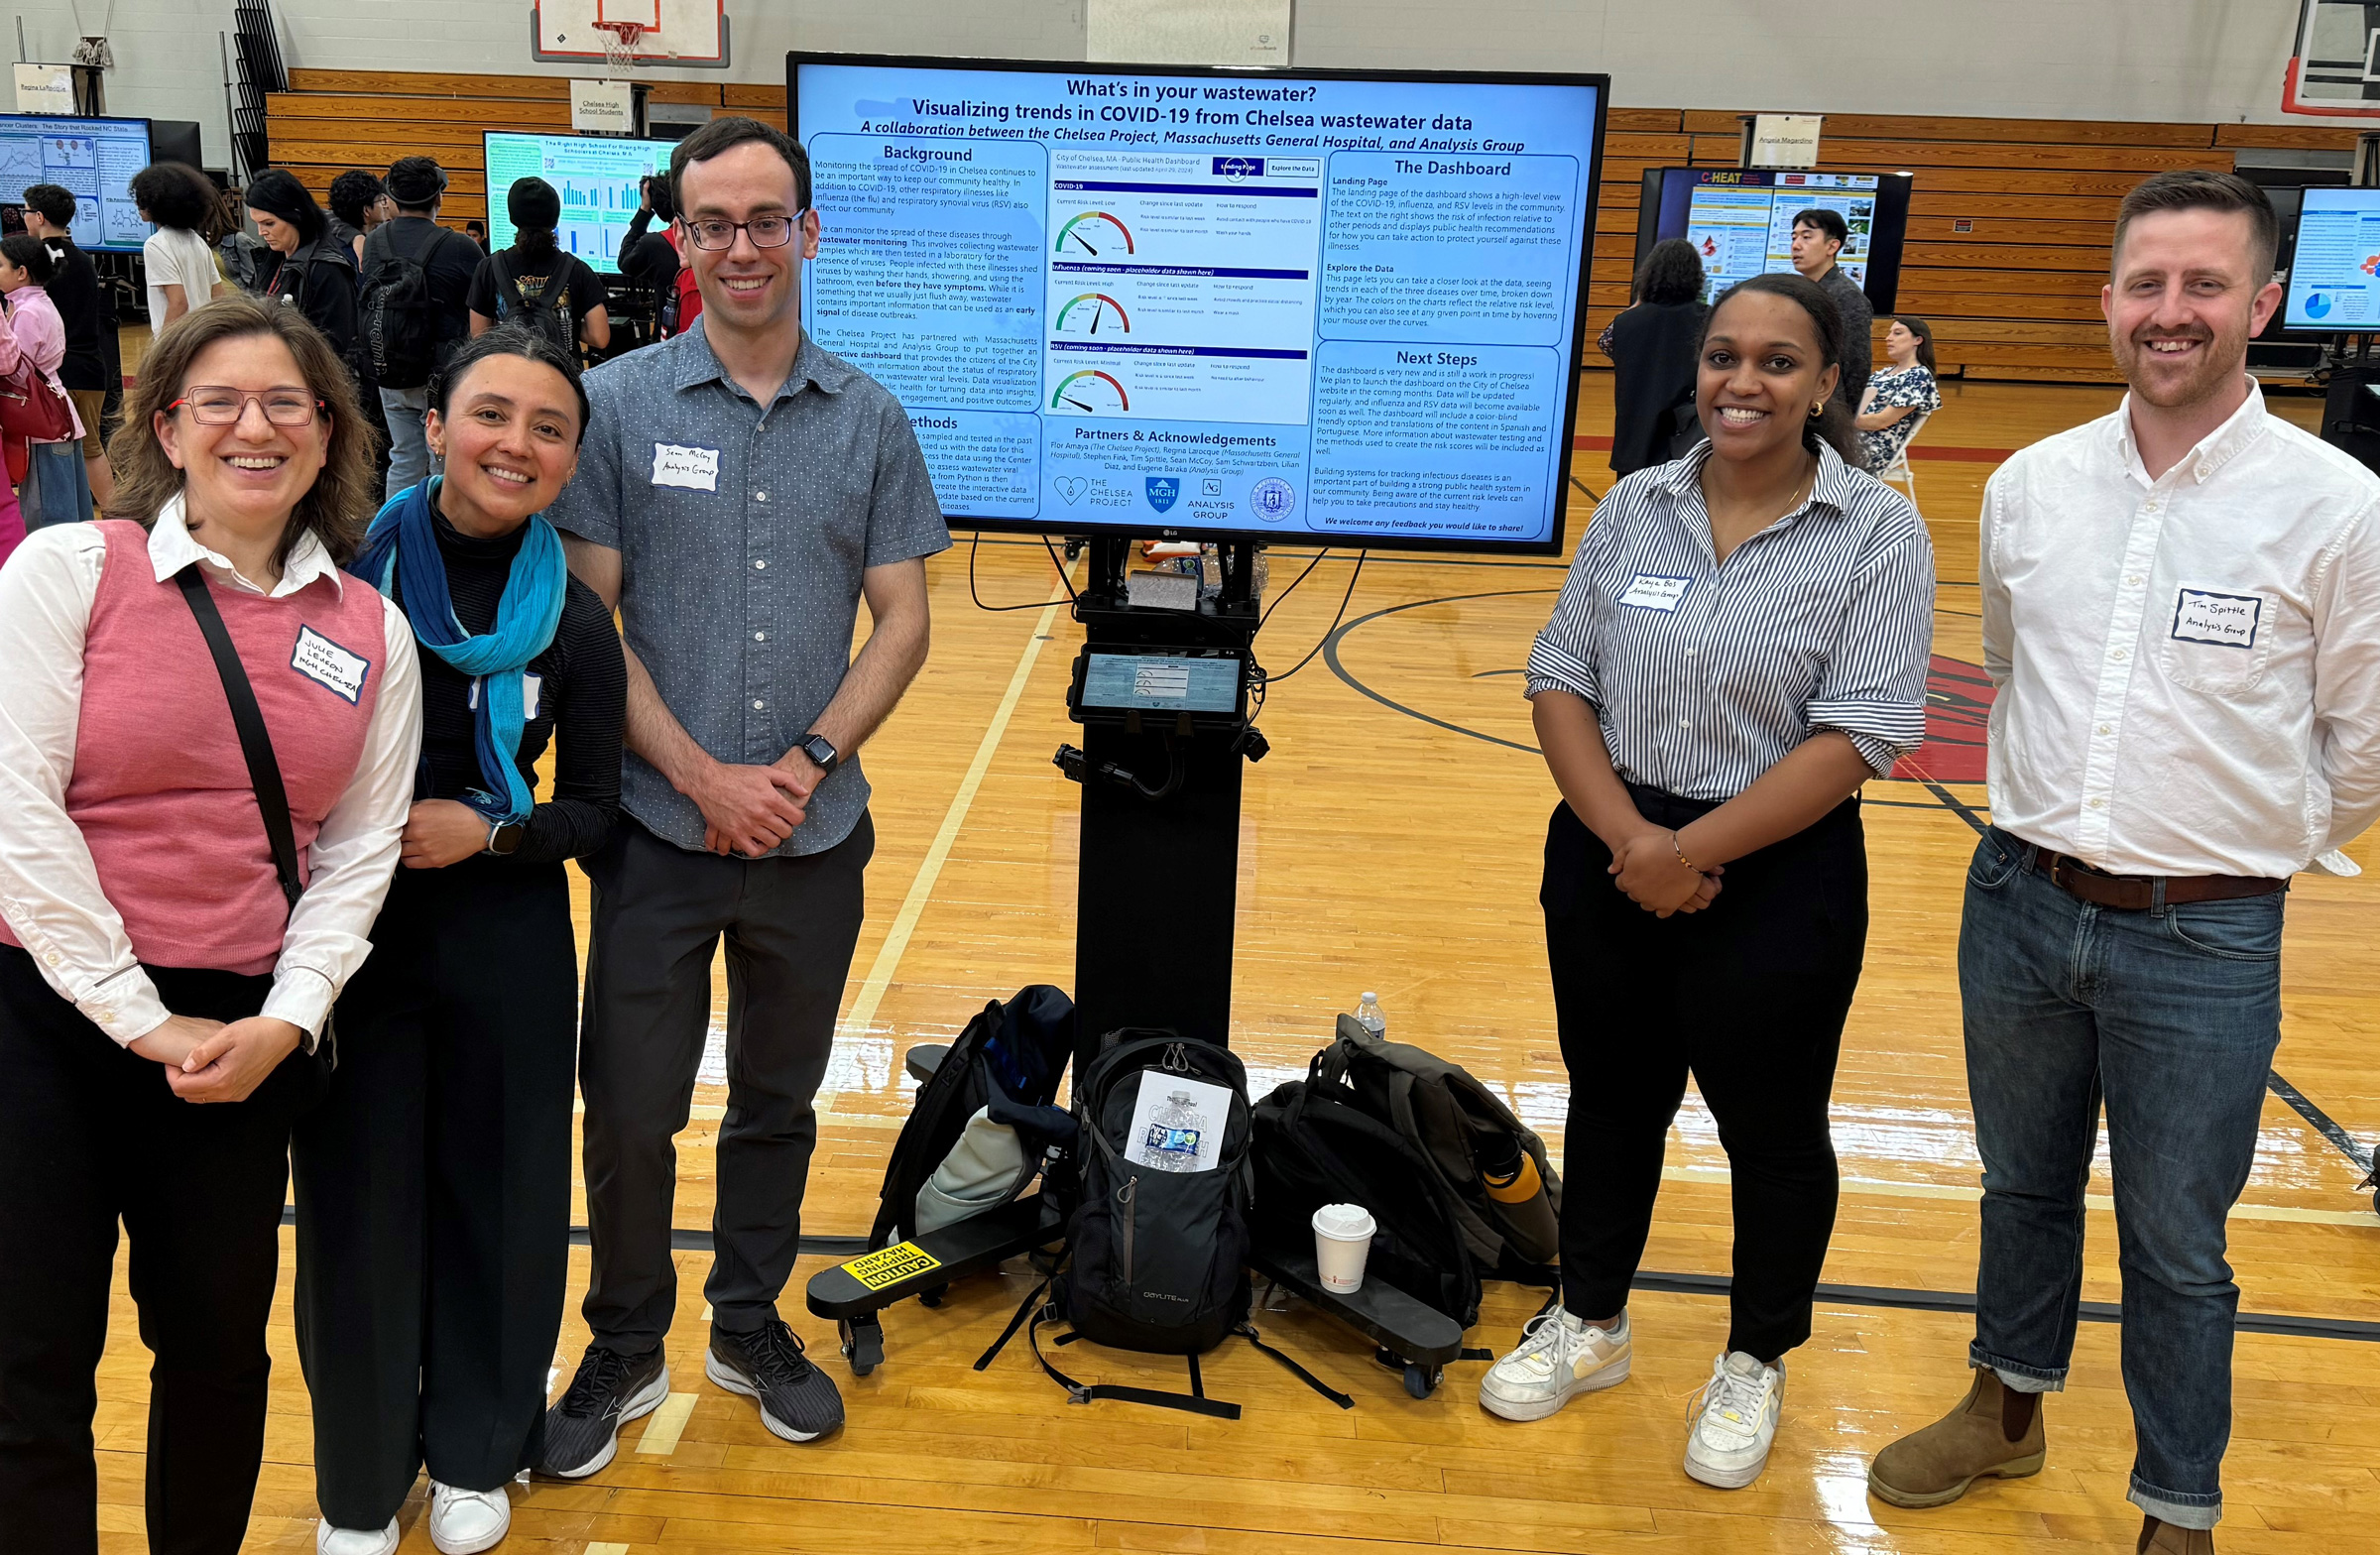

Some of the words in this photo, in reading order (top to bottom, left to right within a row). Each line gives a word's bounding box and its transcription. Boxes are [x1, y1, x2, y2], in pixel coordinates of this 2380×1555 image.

[1066, 78, 1128, 96] What's
[1133, 80, 1149, 97] in
[1155, 86, 1197, 102] your
[1203, 83, 1316, 101] wastewater?
[912, 98, 1009, 122] Visualizing
[1015, 102, 1071, 119] trends
[1078, 104, 1094, 120] in
[1100, 105, 1189, 123] COVID-19
[1195, 107, 1239, 124] from
[1246, 109, 1314, 127] Chelsea
[1320, 112, 1426, 129] wastewater
[1431, 113, 1472, 130] data
[861, 121, 871, 132] A
[875, 120, 964, 137] collaboration
[969, 124, 1023, 138] between
[1028, 126, 1049, 139] the
[1054, 127, 1105, 140] Chelsea
[1110, 129, 1158, 143] Project,
[1163, 131, 1260, 145] Massachusetts
[1265, 133, 1319, 147] General
[1323, 135, 1383, 150] Hospital,
[1389, 137, 1416, 150] and
[1419, 137, 1479, 152] Analysis
[1482, 139, 1524, 154] Group
[885, 145, 971, 164] Background
[815, 161, 856, 171] Monitoring
[873, 163, 897, 172] spread
[910, 164, 947, 173] COVID-19
[989, 167, 1025, 176] continues
[1394, 160, 1422, 174] The
[1428, 160, 1510, 176] Dashboard
[1333, 177, 1365, 185] Landing
[1368, 178, 1387, 186] Page
[1701, 172, 1742, 184] C-HEAT
[1348, 187, 1376, 197] landing
[1400, 188, 1408, 197] of
[1425, 189, 1466, 198] dashboard
[1469, 190, 1492, 199] shows
[1501, 191, 1540, 201] high-level
[1327, 263, 1357, 272] Explore
[1397, 351, 1432, 364] Next
[1437, 352, 1477, 369] Steps
[909, 415, 957, 429] ethods
[1075, 427, 1128, 440] Partners
[1132, 429, 1143, 440] &
[1148, 430, 1275, 446] Acknowledgements
[662, 462, 689, 474] Analysis
[692, 465, 714, 476] Group
[1090, 488, 1132, 497] CHELSEA
[1149, 488, 1174, 497] MGH
[1090, 498, 1130, 507] PROJECT
[1188, 500, 1234, 509] ANALYSIS
[1391, 520, 1427, 529] feedback
[2189, 600, 2206, 609] Tim
[2210, 604, 2245, 616] Spittle
[2186, 617, 2220, 632] Analysis
[2224, 625, 2245, 637] Group
[854, 1246, 907, 1267] HAZARD
[857, 1251, 918, 1275] TRIPPING
[868, 1257, 931, 1286] CAUTION
